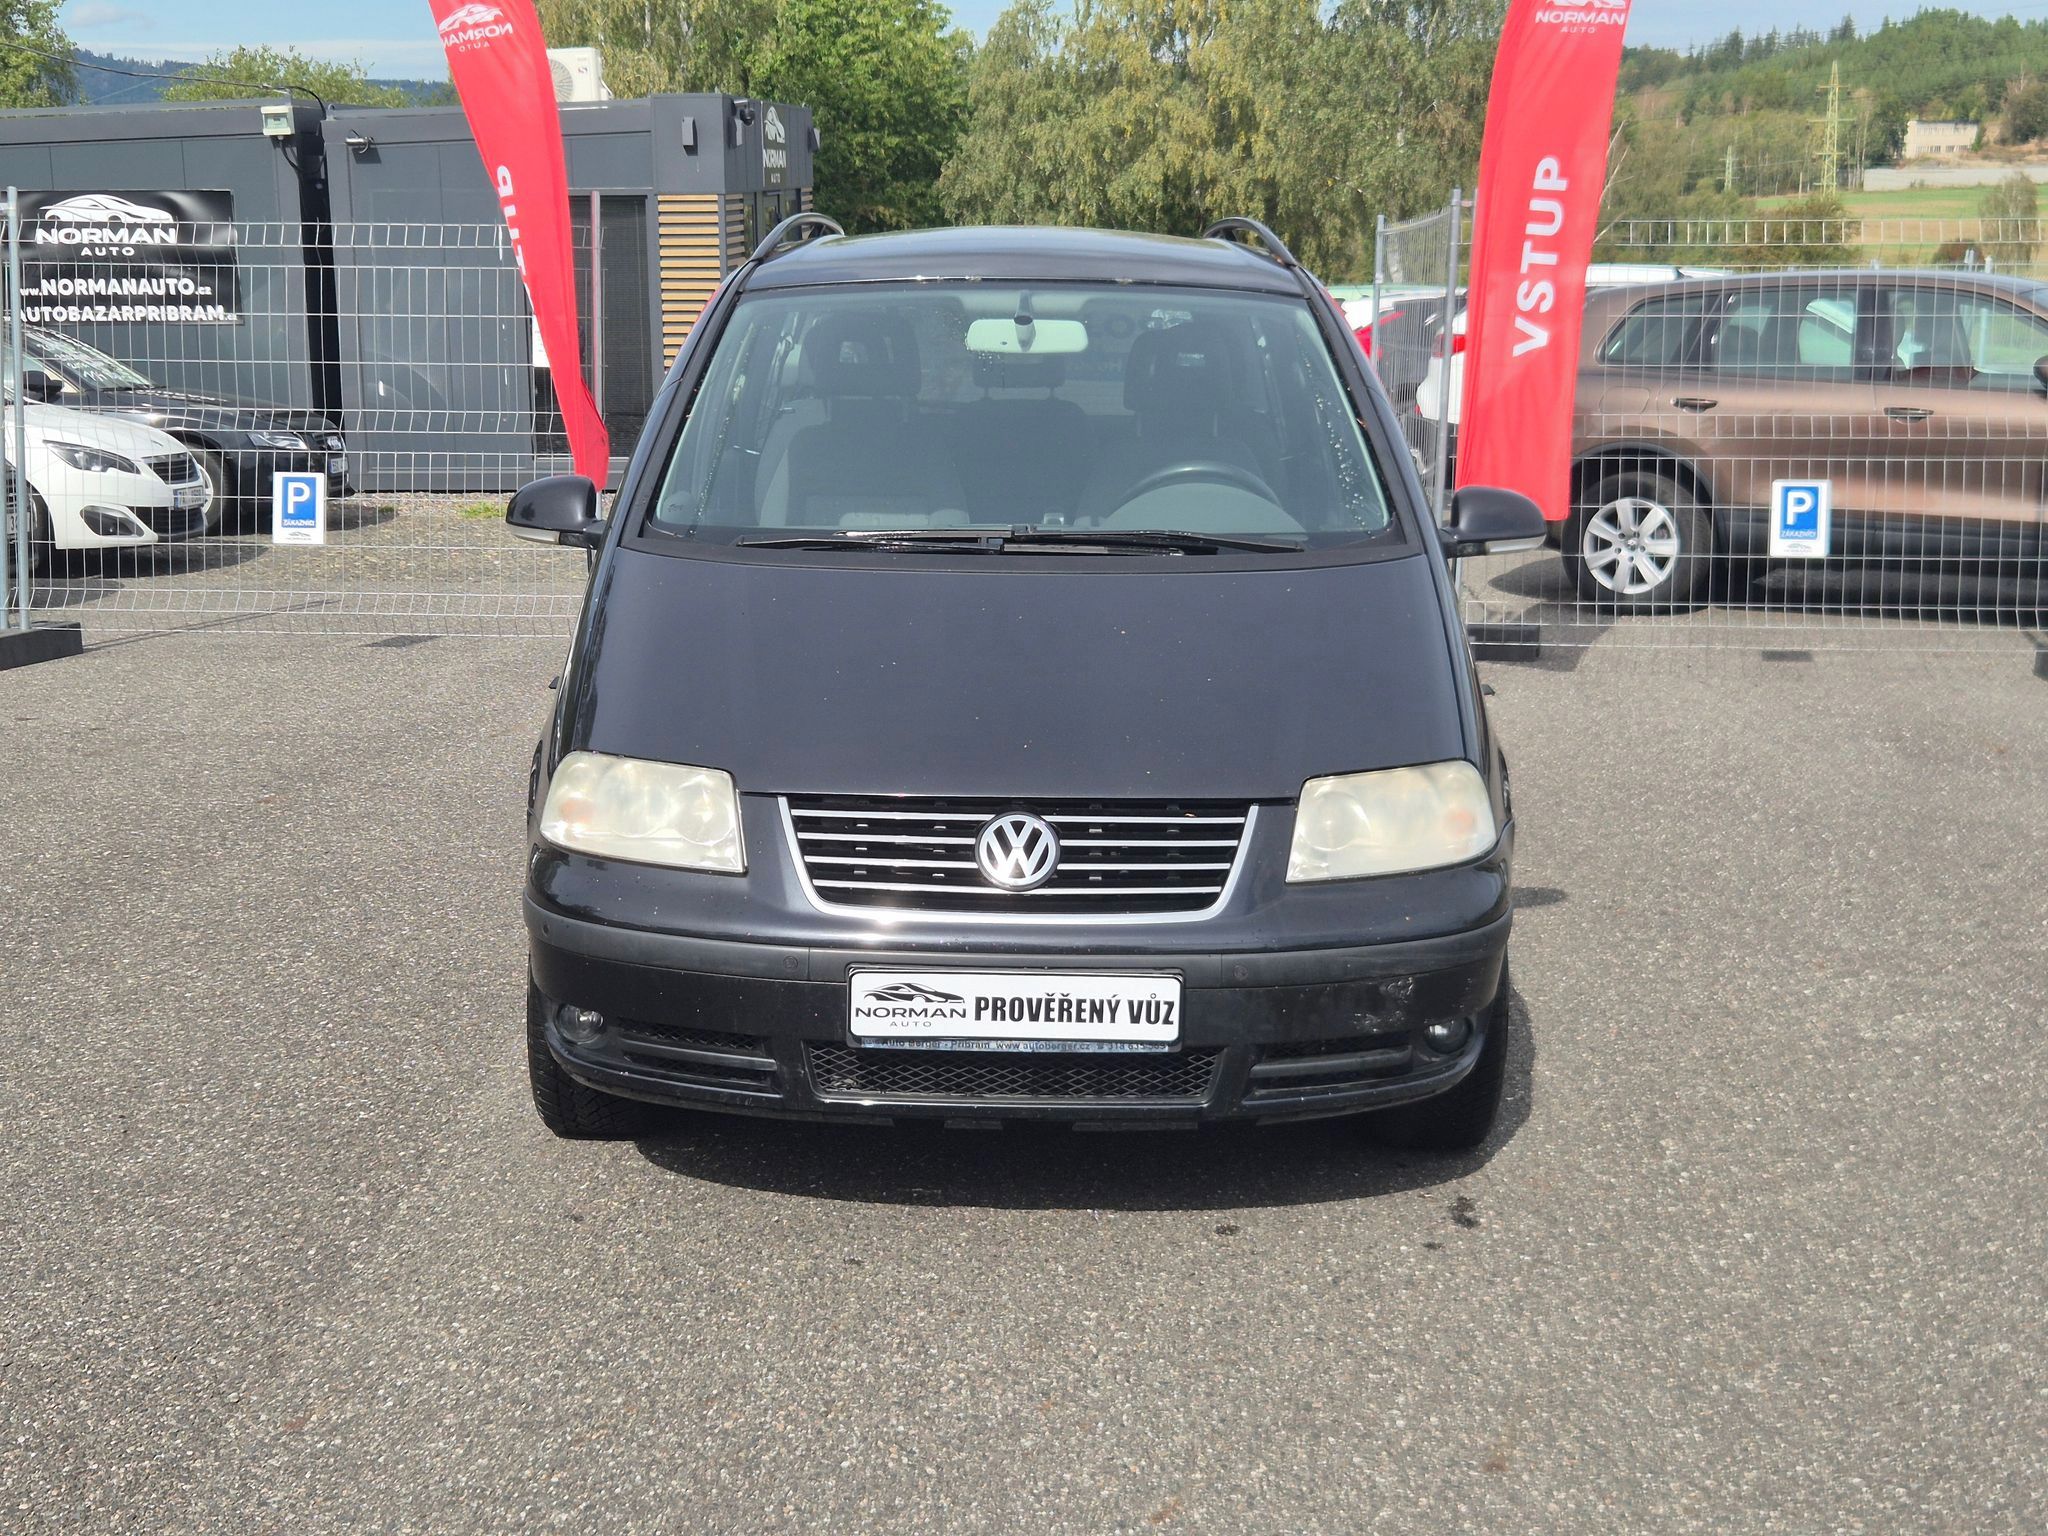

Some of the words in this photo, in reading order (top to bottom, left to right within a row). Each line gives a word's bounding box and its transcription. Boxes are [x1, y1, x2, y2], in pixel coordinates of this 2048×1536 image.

[1535, 11, 1626, 25] NORMAN
[763, 148, 787, 168] NORMAN
[35, 227, 178, 244] NORMAN
[80, 246, 135, 256] AUTO
[1512, 155, 1569, 357] VSTUP
[20, 277, 212, 296] ww.NORMANAUTO.cz
[287, 482, 311, 514] P
[1786, 491, 1813, 526] P
[855, 1007, 966, 1018] NORMAN
[974, 992, 1121, 1024] PROVĚŘENÝ
[1127, 993, 1175, 1025] VŮZ
